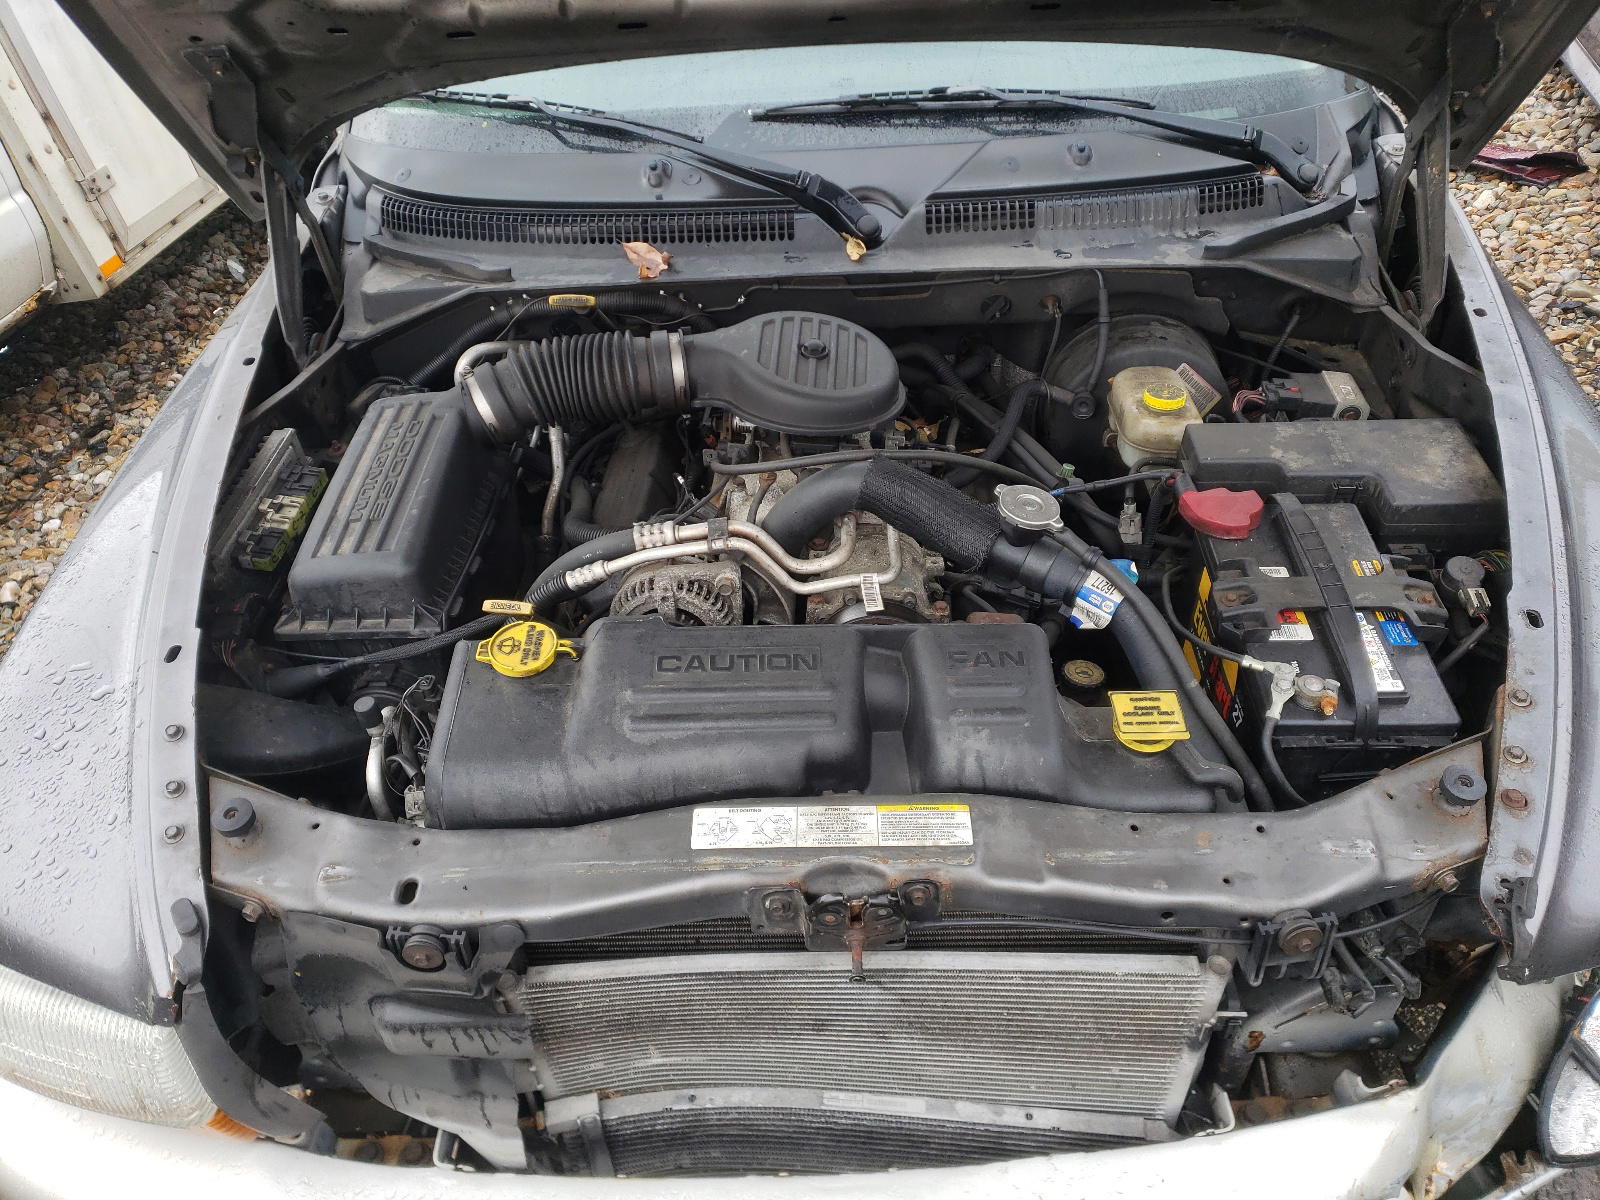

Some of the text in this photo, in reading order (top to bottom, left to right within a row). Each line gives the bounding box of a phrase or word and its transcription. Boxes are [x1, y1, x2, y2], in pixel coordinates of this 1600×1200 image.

[349, 421, 405, 523] MAGNUM
[369, 420, 424, 519] DODGE
[1091, 576, 1117, 596] 16277
[520, 624, 536, 666] FLUID ONLY
[531, 630, 545, 661] WASHER
[655, 650, 1025, 673] CAUTION FAN
